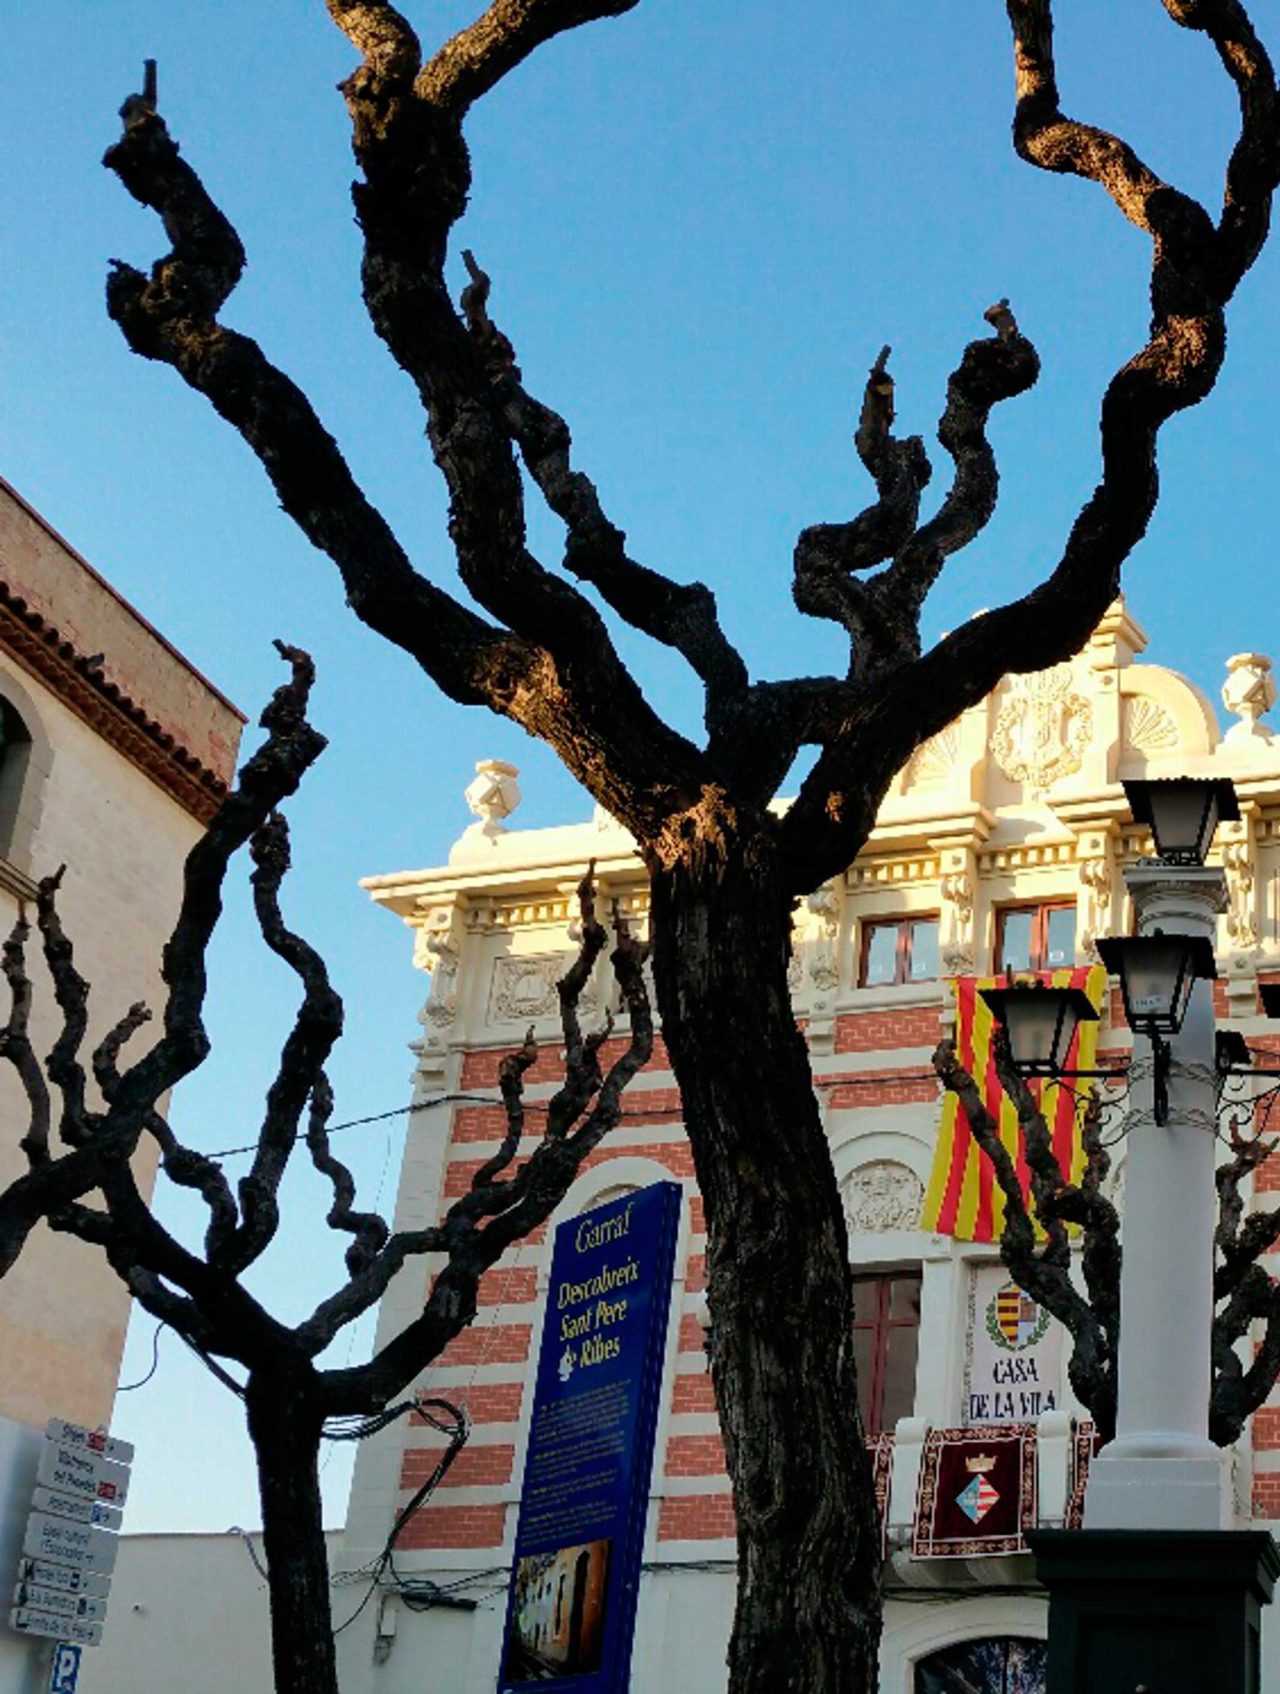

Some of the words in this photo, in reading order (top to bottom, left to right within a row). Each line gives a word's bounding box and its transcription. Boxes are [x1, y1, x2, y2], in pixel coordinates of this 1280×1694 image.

[557, 1256, 641, 1310] Descobreix
[559, 1309, 593, 1342] Sant
[594, 1299, 628, 1330] Pere
[580, 1332, 621, 1369] Ribes
[992, 1357, 1040, 1385] CASA
[969, 1393, 990, 1420] DE
[994, 1391, 1015, 1418] LA
[1019, 1389, 1056, 1417] VILA
